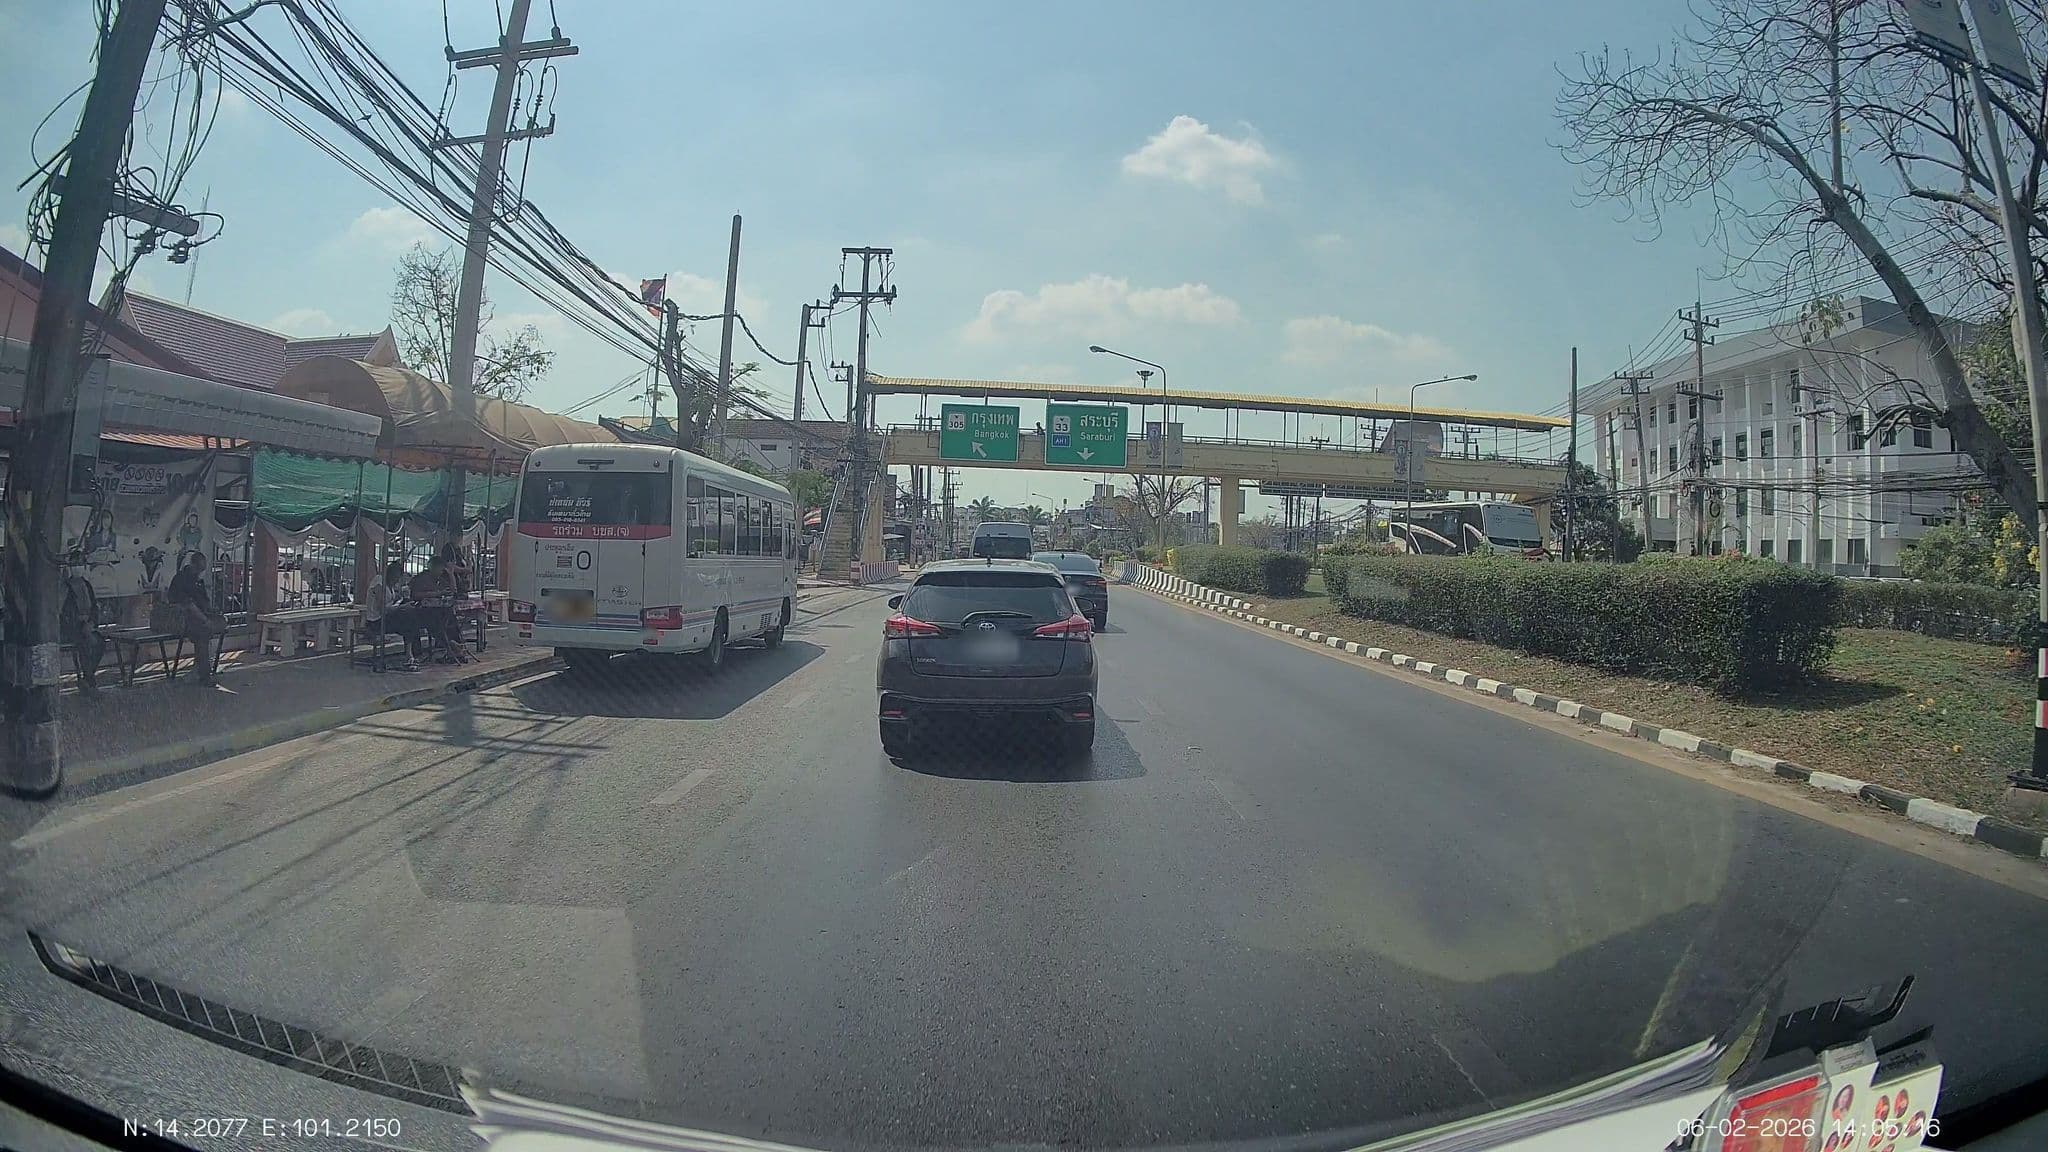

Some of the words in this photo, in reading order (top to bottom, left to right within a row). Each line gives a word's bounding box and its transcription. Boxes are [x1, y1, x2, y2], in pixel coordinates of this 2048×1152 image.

[971, 413, 1014, 428] กรุงเทพ
[1080, 412, 1118, 432] สระบุรี
[1055, 423, 1068, 431] 33
[974, 429, 1009, 440] Bangkok
[1080, 432, 1115, 441] Saraburi
[552, 524, 583, 536] รถร่วม
[592, 525, 630, 537] บขส.(จ)
